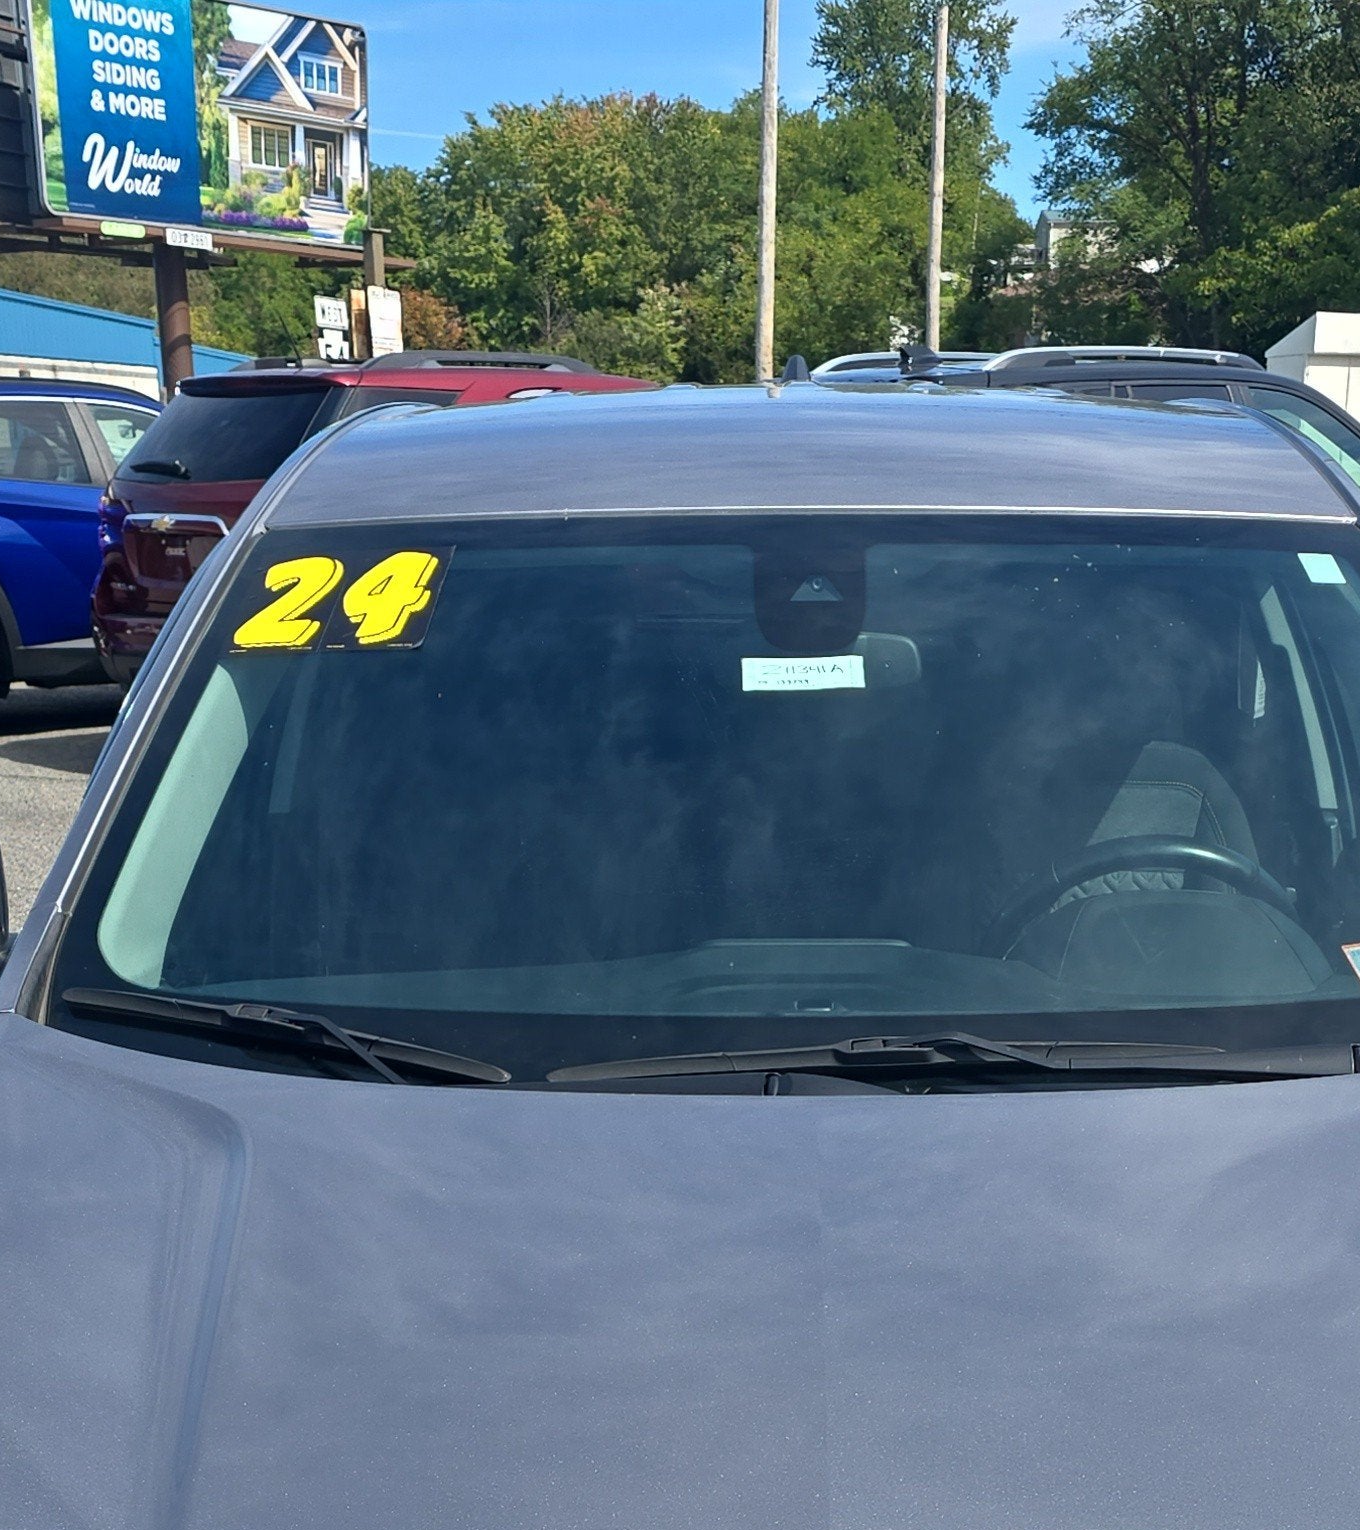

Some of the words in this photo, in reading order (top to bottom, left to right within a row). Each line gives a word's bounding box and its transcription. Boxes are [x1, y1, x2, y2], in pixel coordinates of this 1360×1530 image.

[69, 0, 175, 36] WINDOWS
[88, 28, 161, 62] DOORS
[92, 59, 161, 91] SIDING
[90, 89, 106, 112] &
[108, 91, 167, 122] MORE
[82, 132, 181, 193] Window
[233, 550, 439, 648] 24
